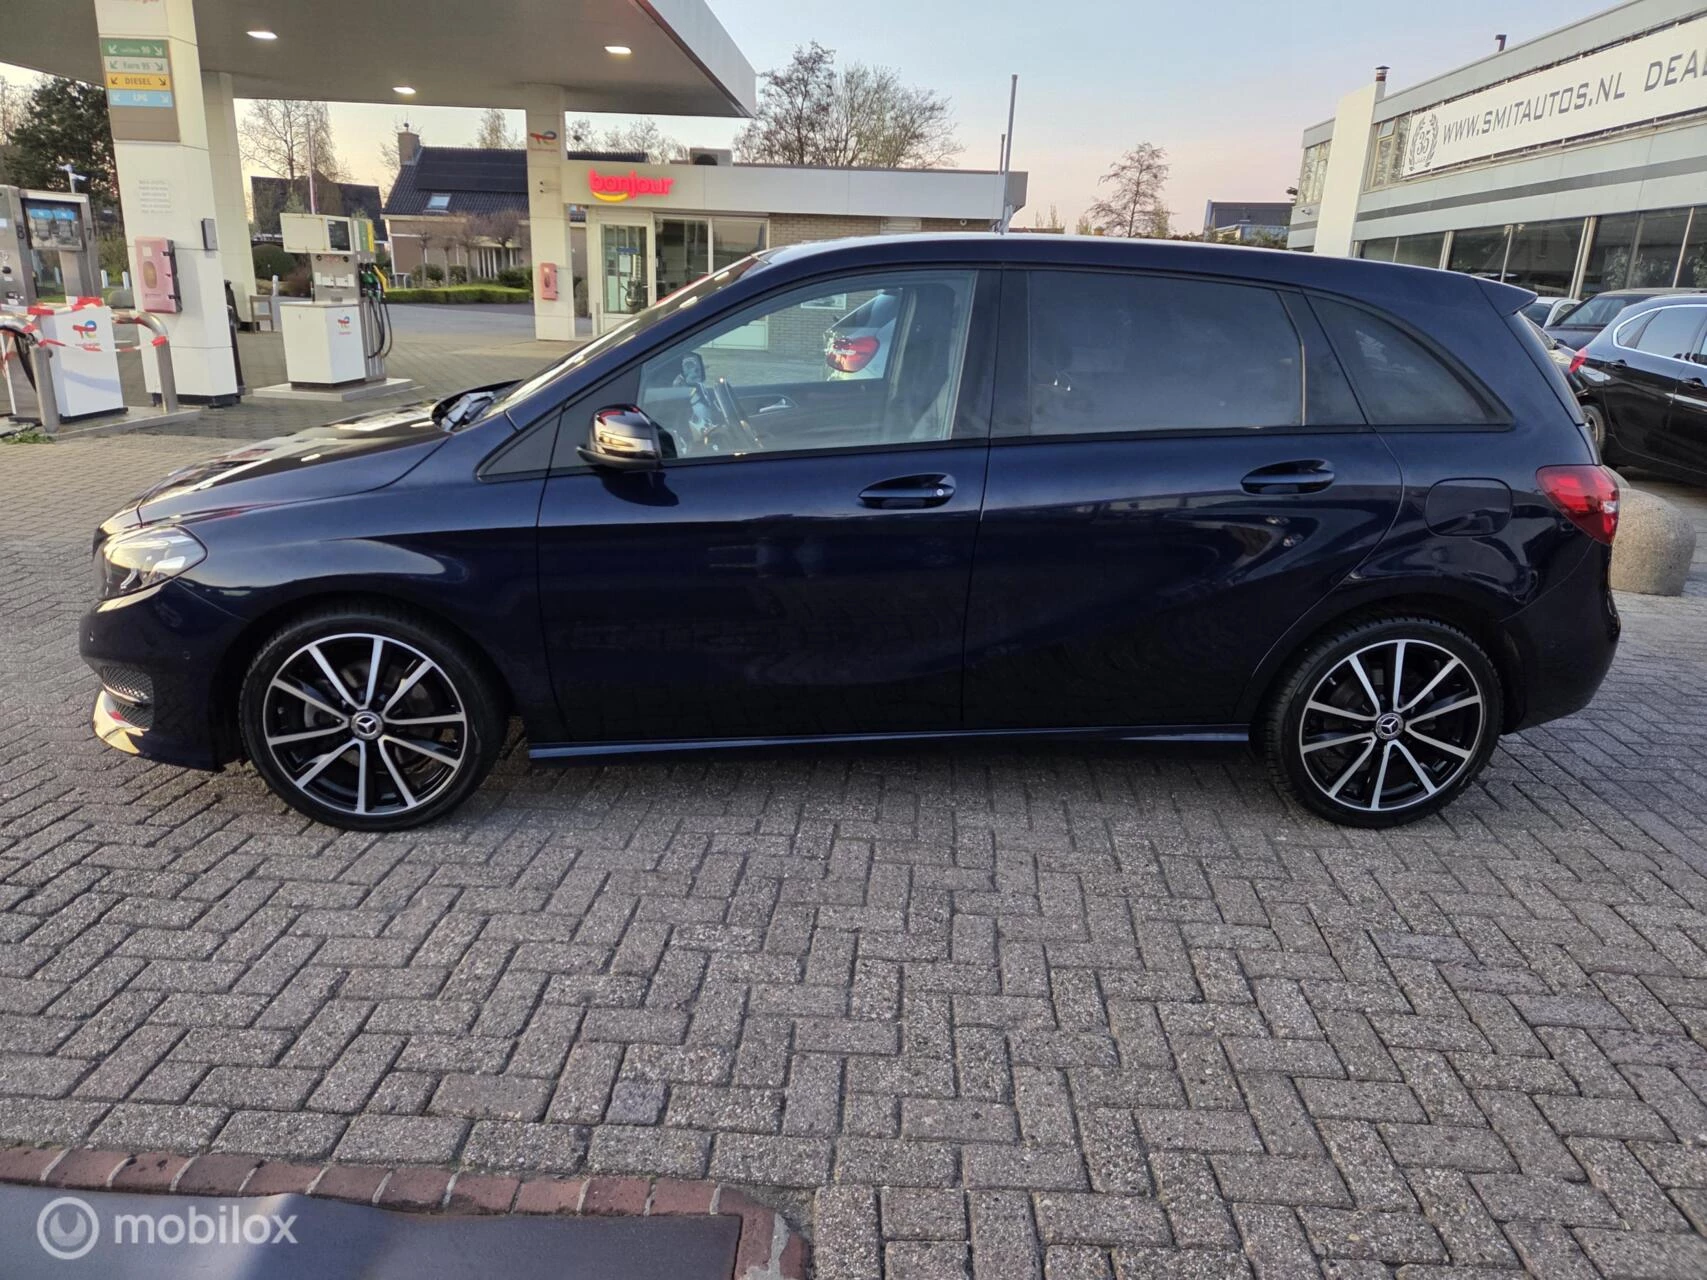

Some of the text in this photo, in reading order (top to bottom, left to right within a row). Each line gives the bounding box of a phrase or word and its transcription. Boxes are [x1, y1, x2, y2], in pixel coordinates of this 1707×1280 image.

[125, 78, 152, 86] DIESEL
[1443, 71, 1626, 145] WWW.SMITAUTOS.NL
[589, 169, 673, 198] bonjour
